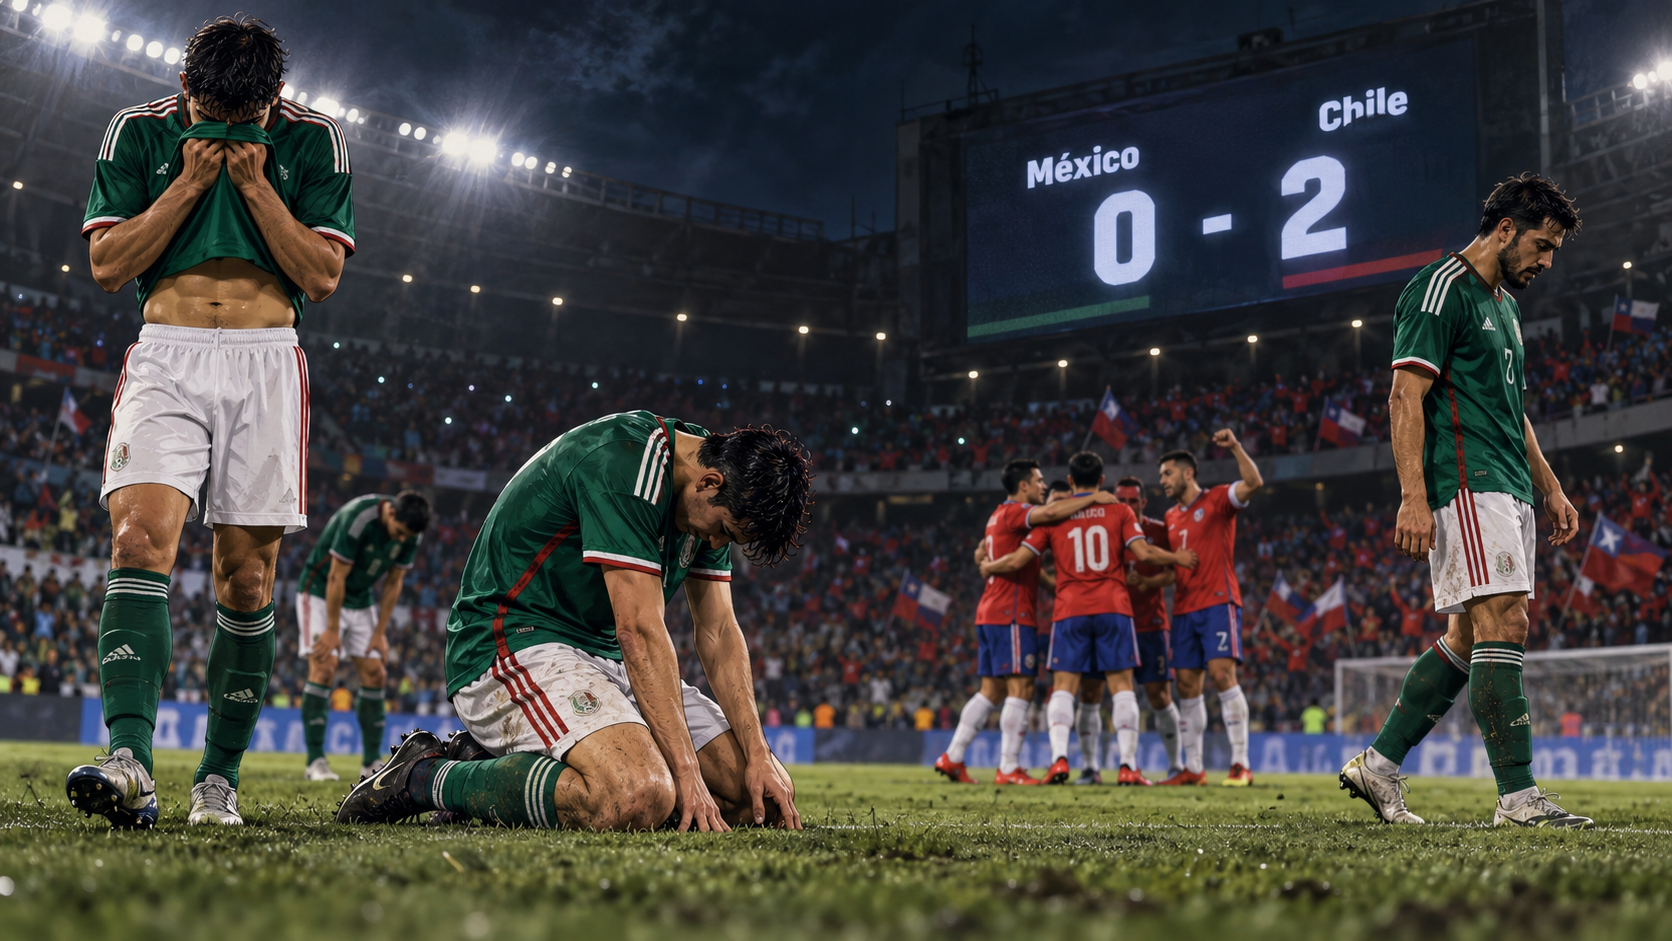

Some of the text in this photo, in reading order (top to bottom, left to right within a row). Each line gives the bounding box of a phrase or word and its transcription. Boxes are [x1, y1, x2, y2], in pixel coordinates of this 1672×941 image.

[1318, 87, 1409, 132] Chile
[1026, 145, 1140, 189] México
[1093, 189, 1156, 286] 0
[1281, 155, 1347, 261] 2
[1067, 524, 1110, 574] 10
